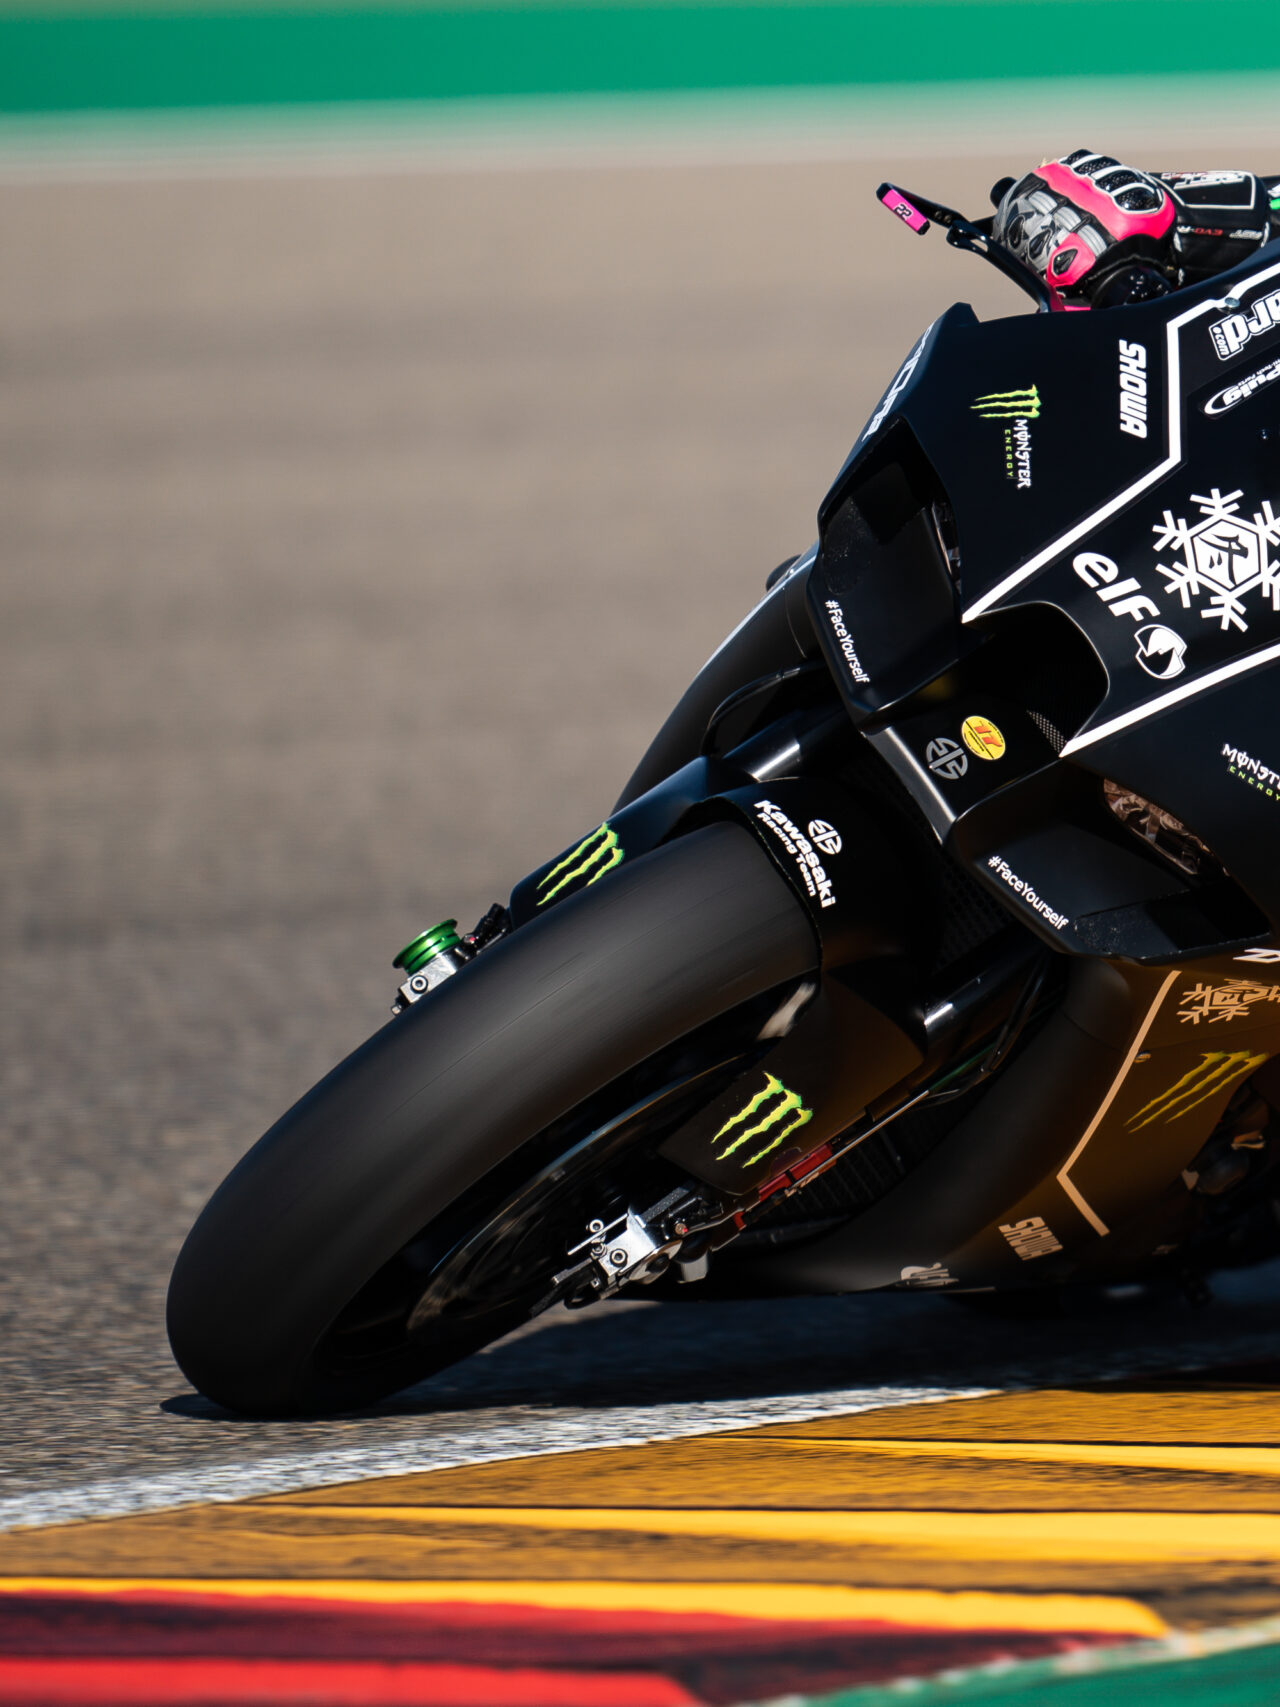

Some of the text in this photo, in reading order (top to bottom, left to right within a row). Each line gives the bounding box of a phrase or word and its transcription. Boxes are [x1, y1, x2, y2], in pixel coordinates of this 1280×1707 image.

[1119, 340, 1148, 439] SHOWA
[1004, 429, 1014, 478] ENERGY
[1013, 418, 1032, 490] MONSTER
[1072, 551, 1161, 622] elf
[825, 600, 871, 684] #FaceYourself
[754, 800, 836, 908] Kawasaki
[757, 812, 817, 897] Racing Team
[987, 855, 1069, 931] #FaceYourself
[998, 1216, 1064, 1261] SHOWA
